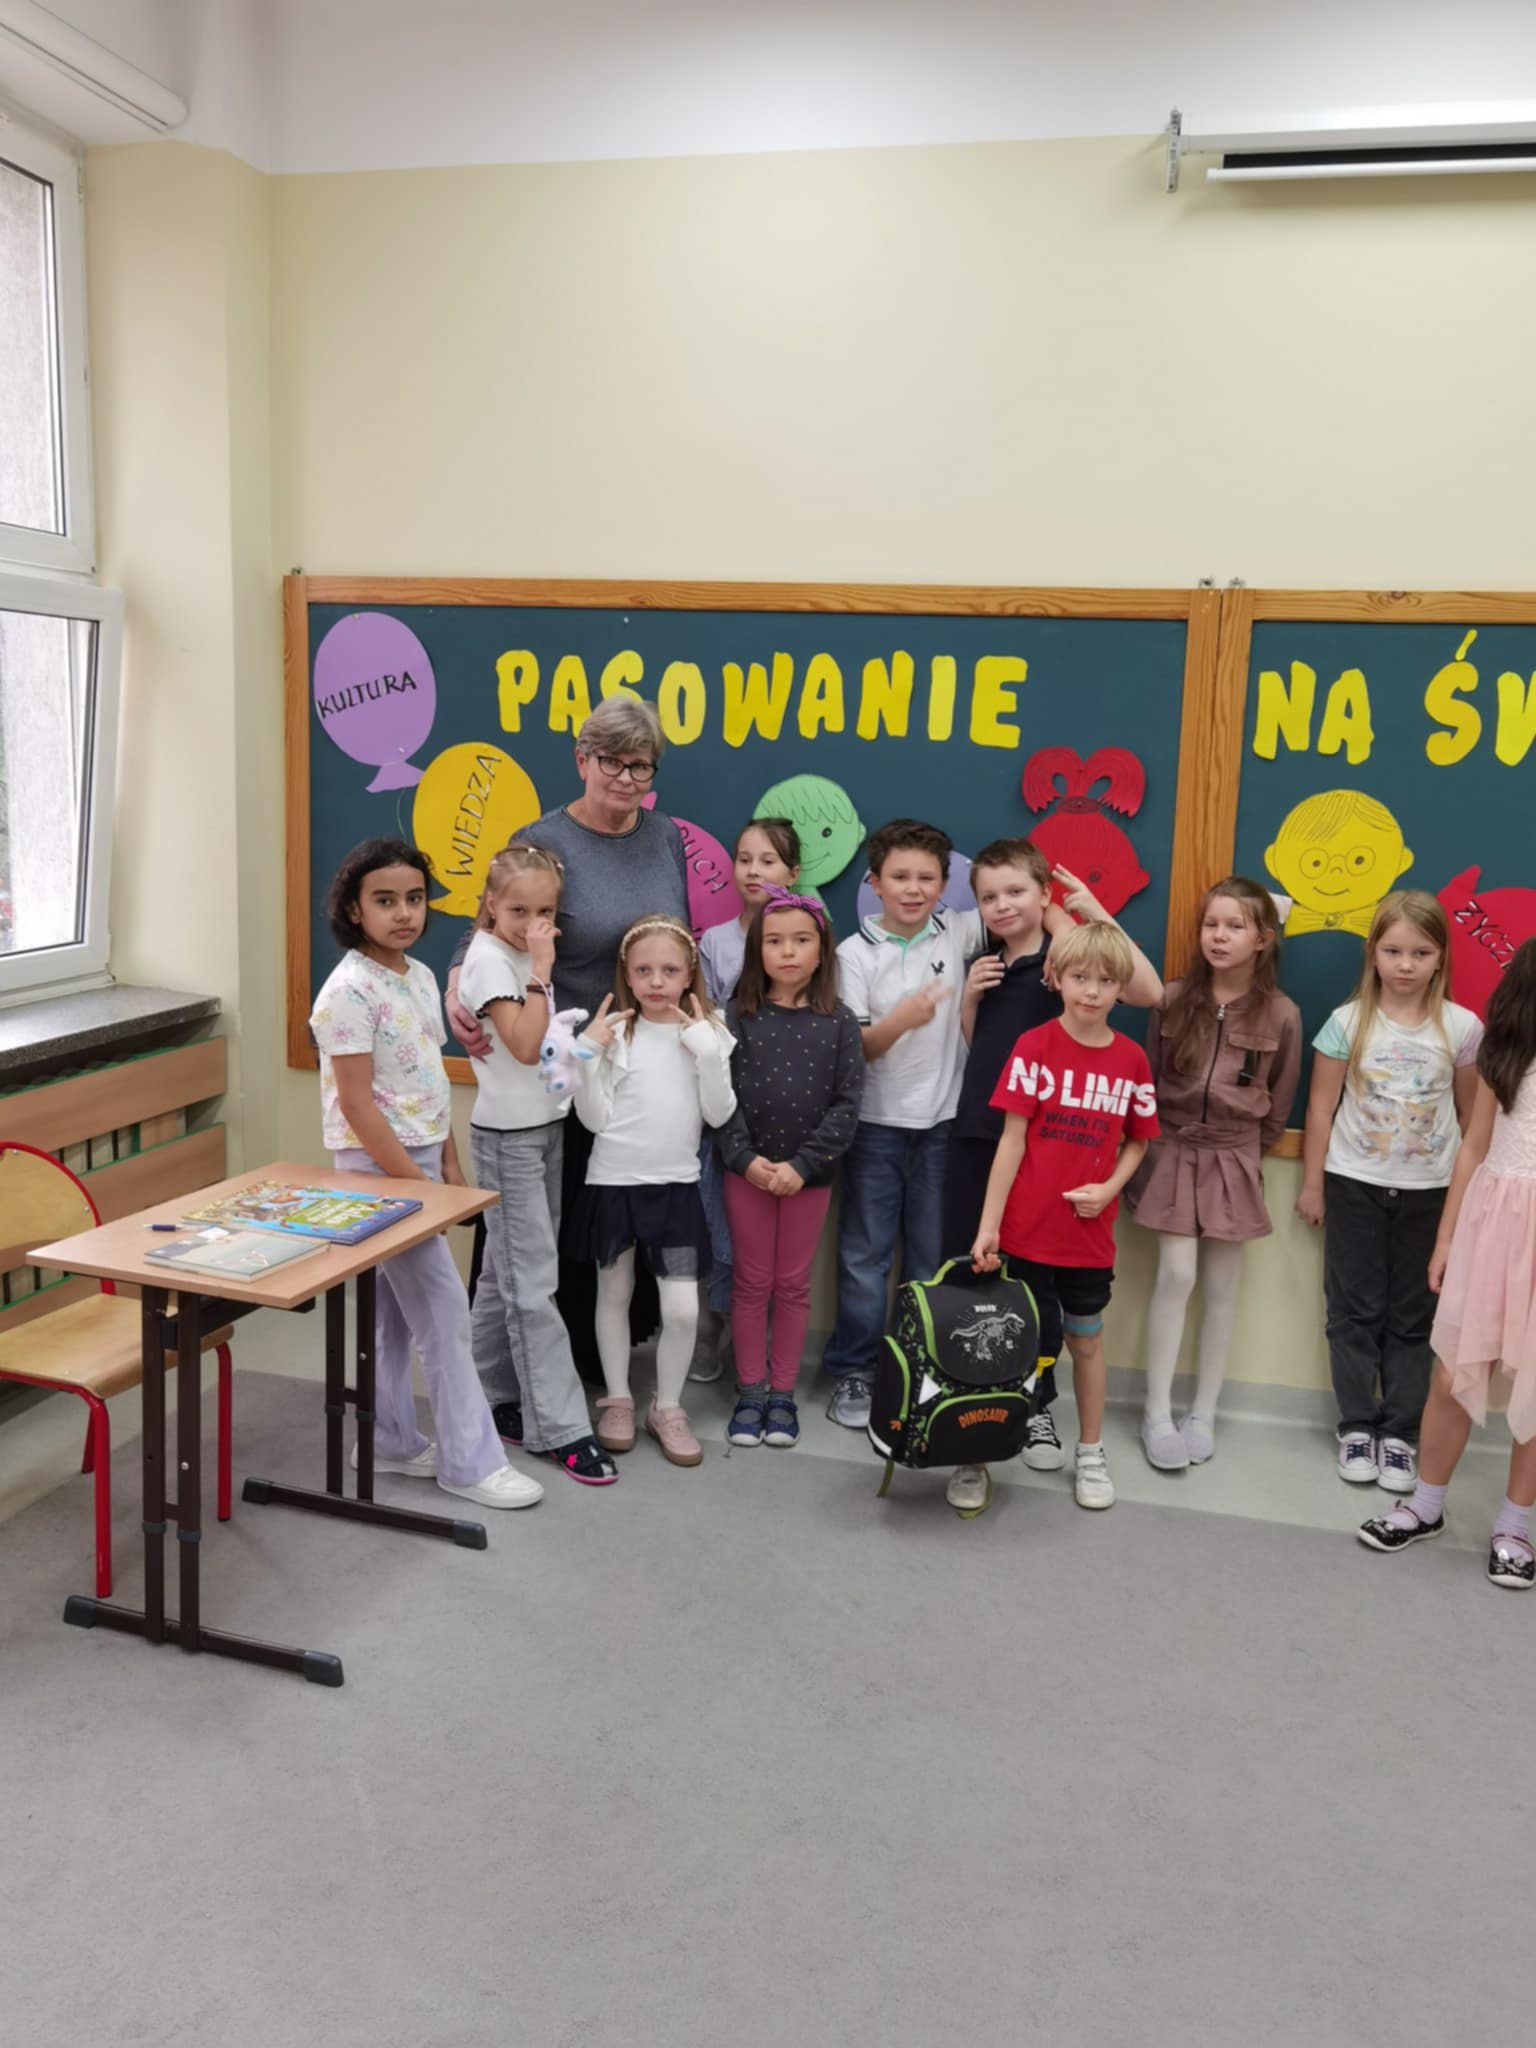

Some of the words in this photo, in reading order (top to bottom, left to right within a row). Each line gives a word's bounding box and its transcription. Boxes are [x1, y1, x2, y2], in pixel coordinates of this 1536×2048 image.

[317, 670, 417, 719] KULTURA
[496, 649, 1028, 749] PASOWANIE
[1253, 660, 1375, 765] NA
[445, 754, 502, 876] WIEDZA
[1060, 1069, 1157, 1118] LIMIS
[1045, 1112, 1088, 1128] WHEN
[959, 1408, 1008, 1429] DINOSAUR
